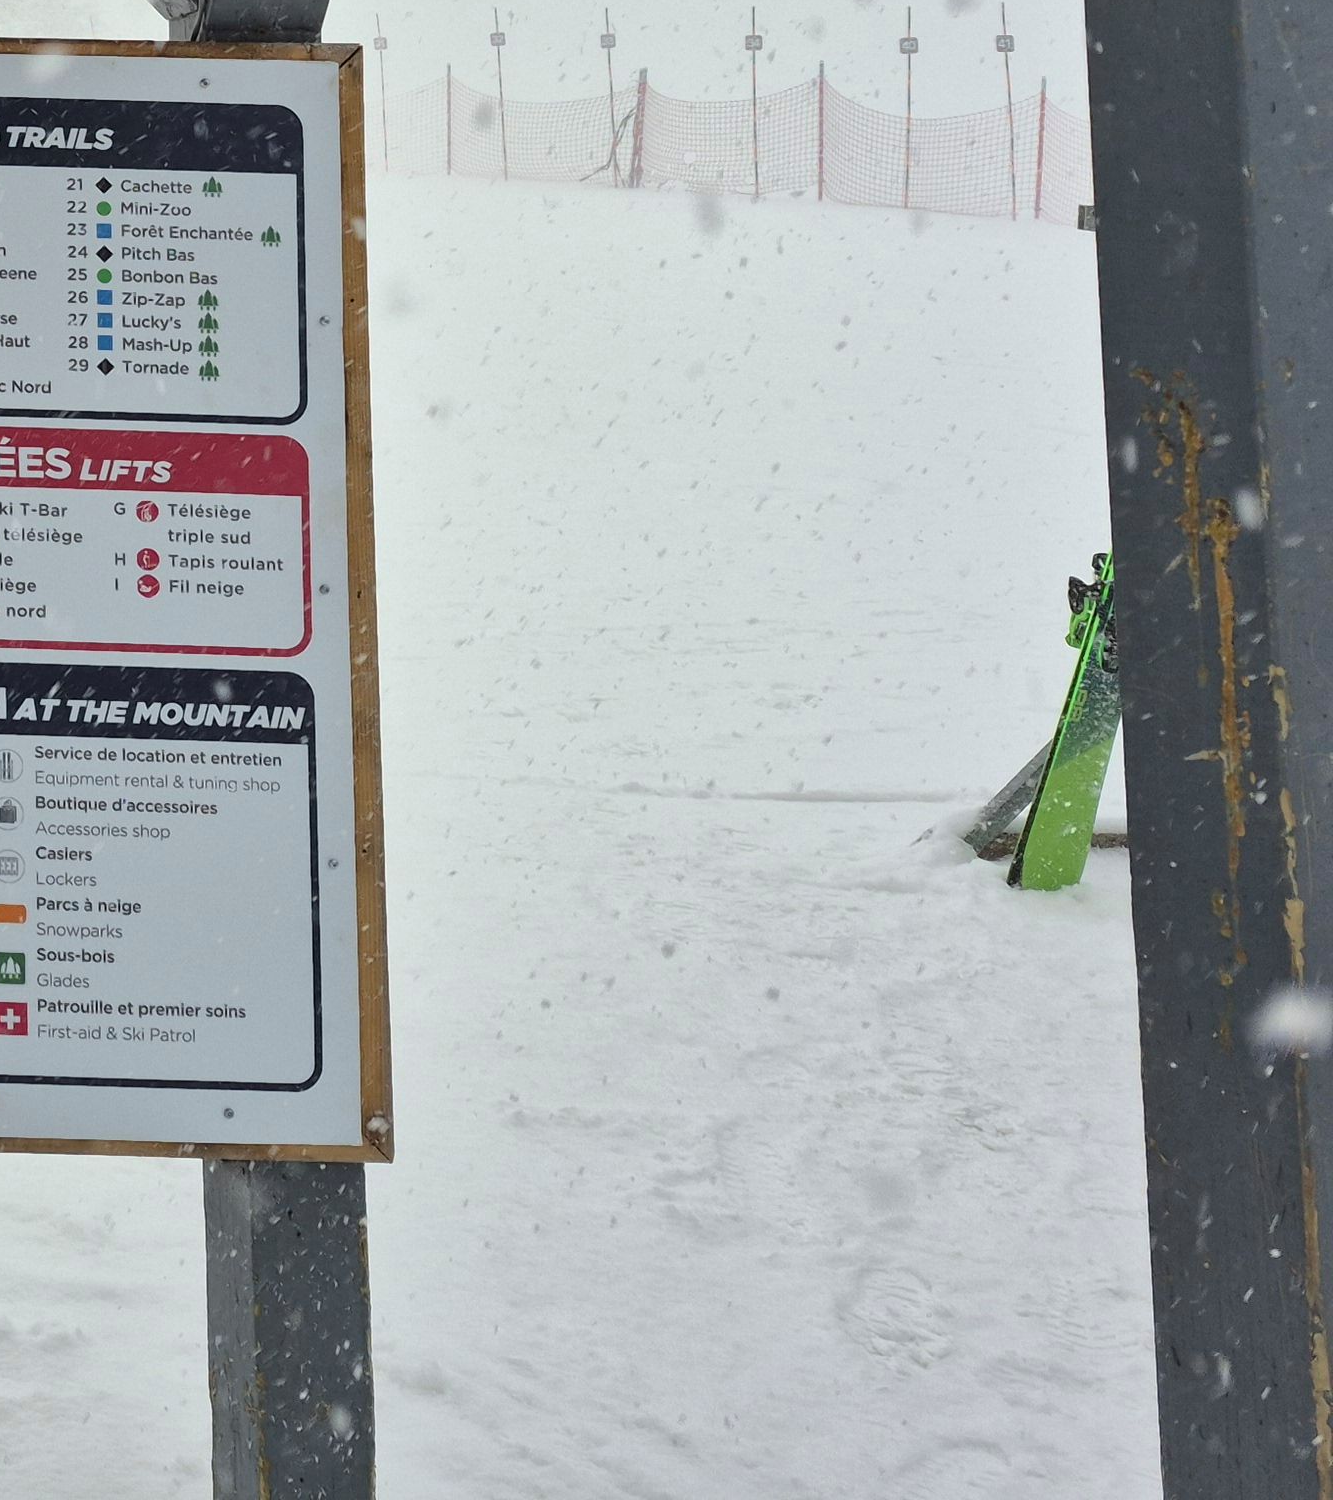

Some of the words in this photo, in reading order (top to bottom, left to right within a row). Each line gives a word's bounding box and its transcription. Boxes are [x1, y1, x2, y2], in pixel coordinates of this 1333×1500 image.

[7, 126, 114, 150] TRAILS
[121, 180, 192, 194] Cachette
[121, 202, 191, 216] Mini-Zoo
[121, 224, 164, 238] Forêt
[169, 226, 253, 241] Enchantée
[122, 292, 185, 309] Zip-Zap
[122, 315, 181, 331] Lucky's
[122, 337, 192, 354] Mash-Up
[122, 360, 189, 375] Tornade
[80, 459, 172, 482] LIFTS
[20, 503, 67, 517] T-Bar
[167, 504, 251, 521] Télésiège
[168, 529, 214, 545] triple
[221, 531, 250, 545] sud
[168, 554, 215, 570] Tapis
[222, 557, 283, 571] roulant
[169, 580, 189, 593] Fil
[197, 581, 244, 597] neige
[7, 605, 46, 618] nord
[13, 698, 61, 721] AT
[67, 700, 129, 726] THE
[133, 702, 305, 731] MOUNTAIN
[35, 746, 92, 760] Service
[98, 748, 117, 761] de
[122, 748, 185, 763] location
[191, 752, 206, 764] et
[211, 753, 282, 767] entretien
[36, 796, 107, 813] Boutique
[36, 846, 92, 861] Casiers
[37, 897, 79, 911] Parcs
[84, 898, 92, 912] à
[98, 899, 141, 915] neige
[37, 922, 122, 939] Snowparks
[37, 948, 115, 963] Sous-bois
[38, 998, 113, 1014] Patrouille
[118, 1002, 133, 1015] et
[139, 1003, 201, 1018] premier
[206, 1004, 246, 1018] soins
